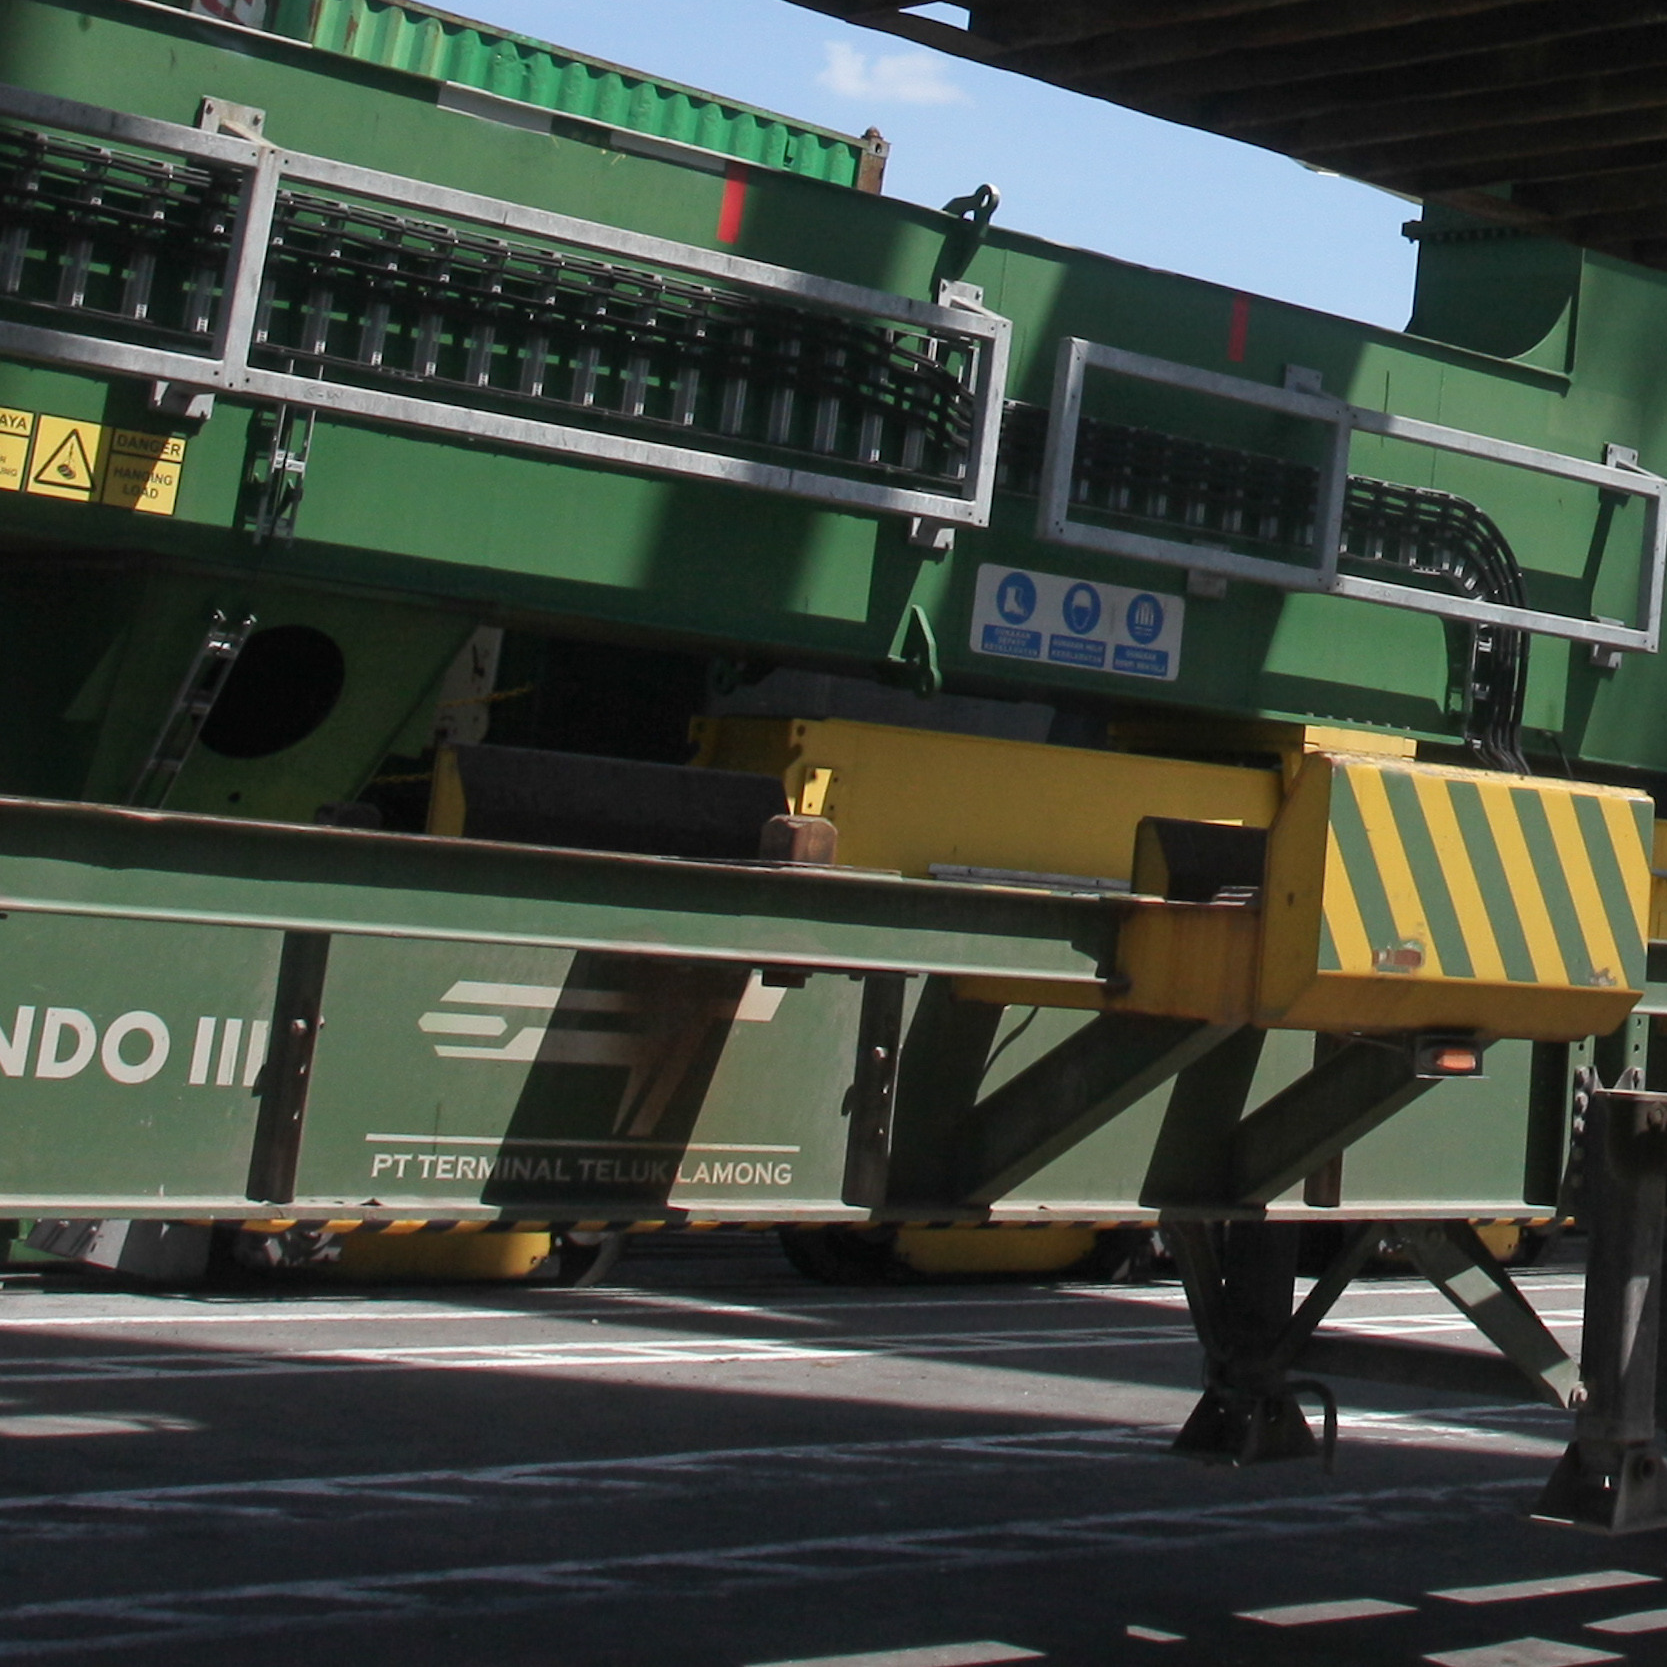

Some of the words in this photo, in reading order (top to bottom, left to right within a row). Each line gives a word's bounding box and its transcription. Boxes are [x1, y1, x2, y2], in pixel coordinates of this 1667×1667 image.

[117, 435, 181, 457] DANGER
[114, 467, 173, 486] HANGING
[123, 484, 159, 499] LOAD
[0, 1005, 170, 1083] NDO
[188, 1016, 269, 1087] III
[371, 1154, 413, 1178] PT
[418, 1155, 571, 1182] TERMINAL
[578, 1159, 669, 1183] TELUK
[675, 1161, 793, 1185] LAMONG
